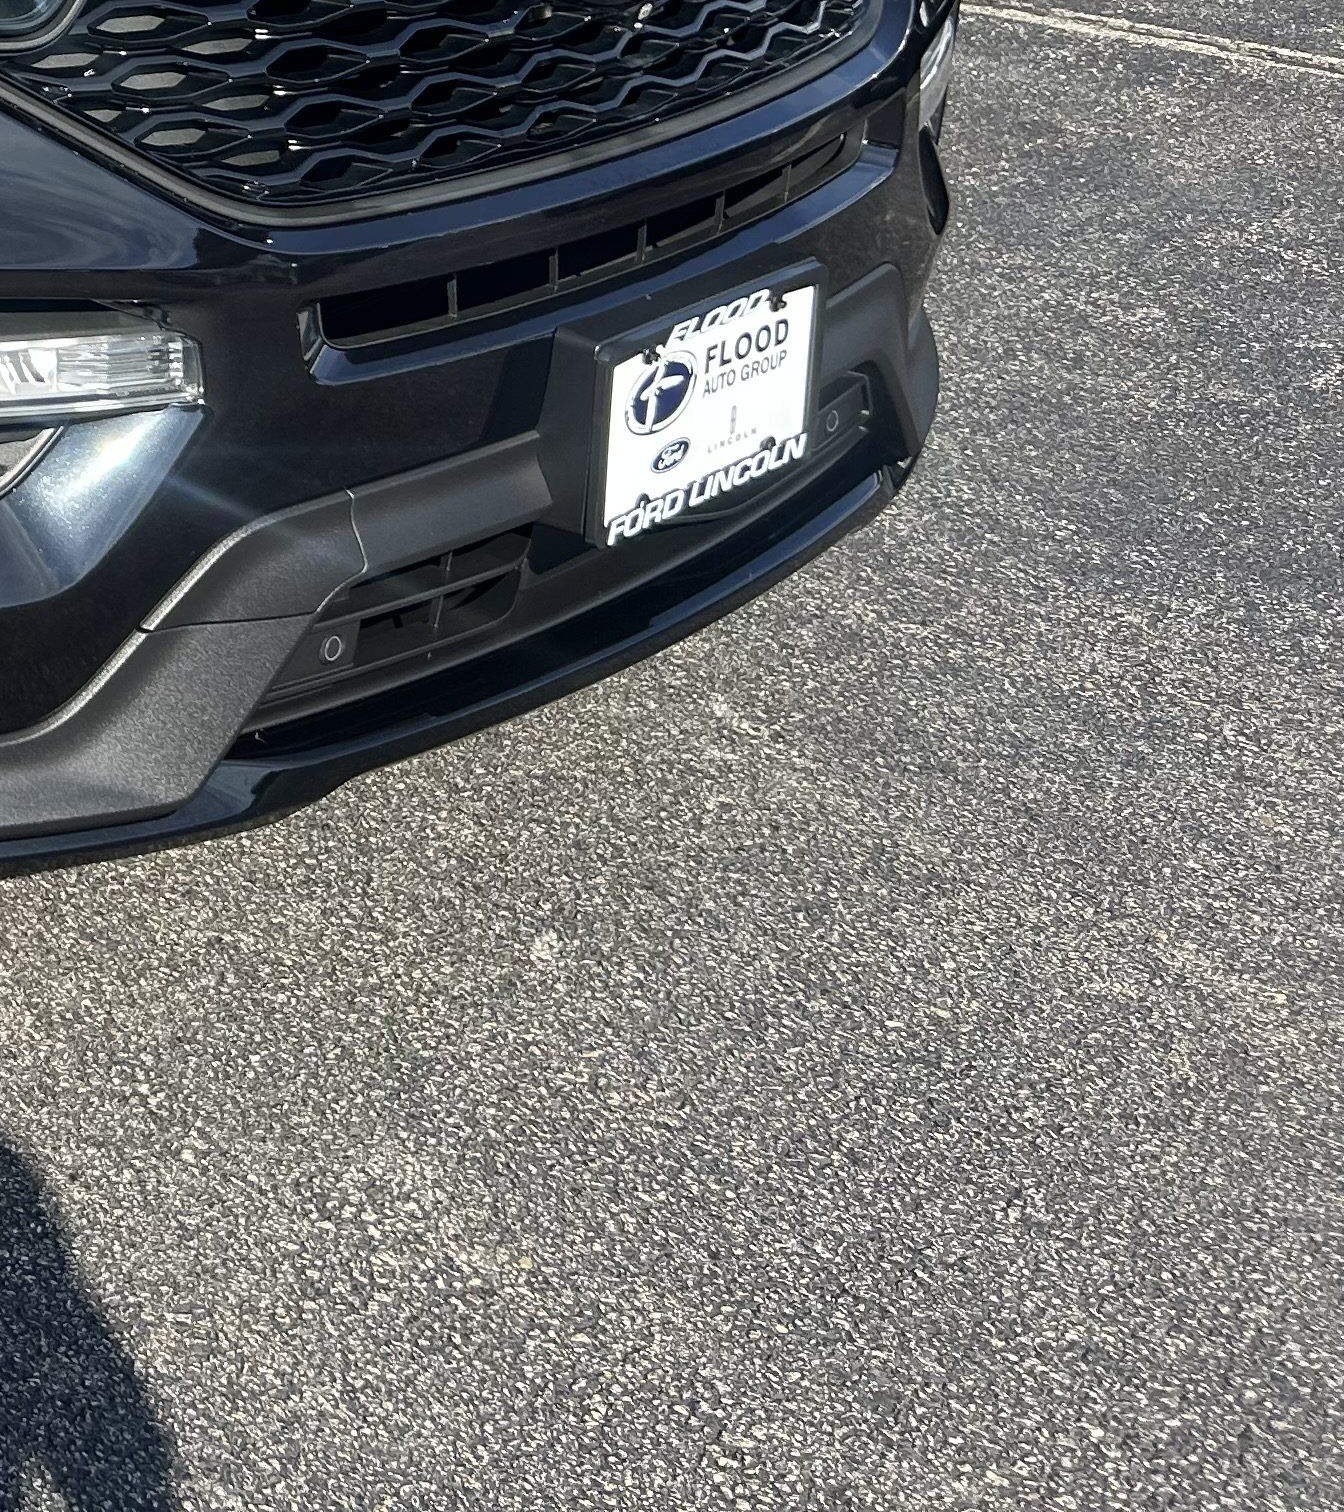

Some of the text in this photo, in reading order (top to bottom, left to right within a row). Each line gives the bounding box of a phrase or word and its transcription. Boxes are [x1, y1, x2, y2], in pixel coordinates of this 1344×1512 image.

[665, 288, 771, 348] FLOOD
[704, 318, 790, 374] FLOOD
[702, 350, 788, 398] AUTO GROUP
[658, 443, 685, 470] Ford
[707, 427, 757, 454] LINCOLN
[607, 433, 808, 547] FORD LINCOLN
